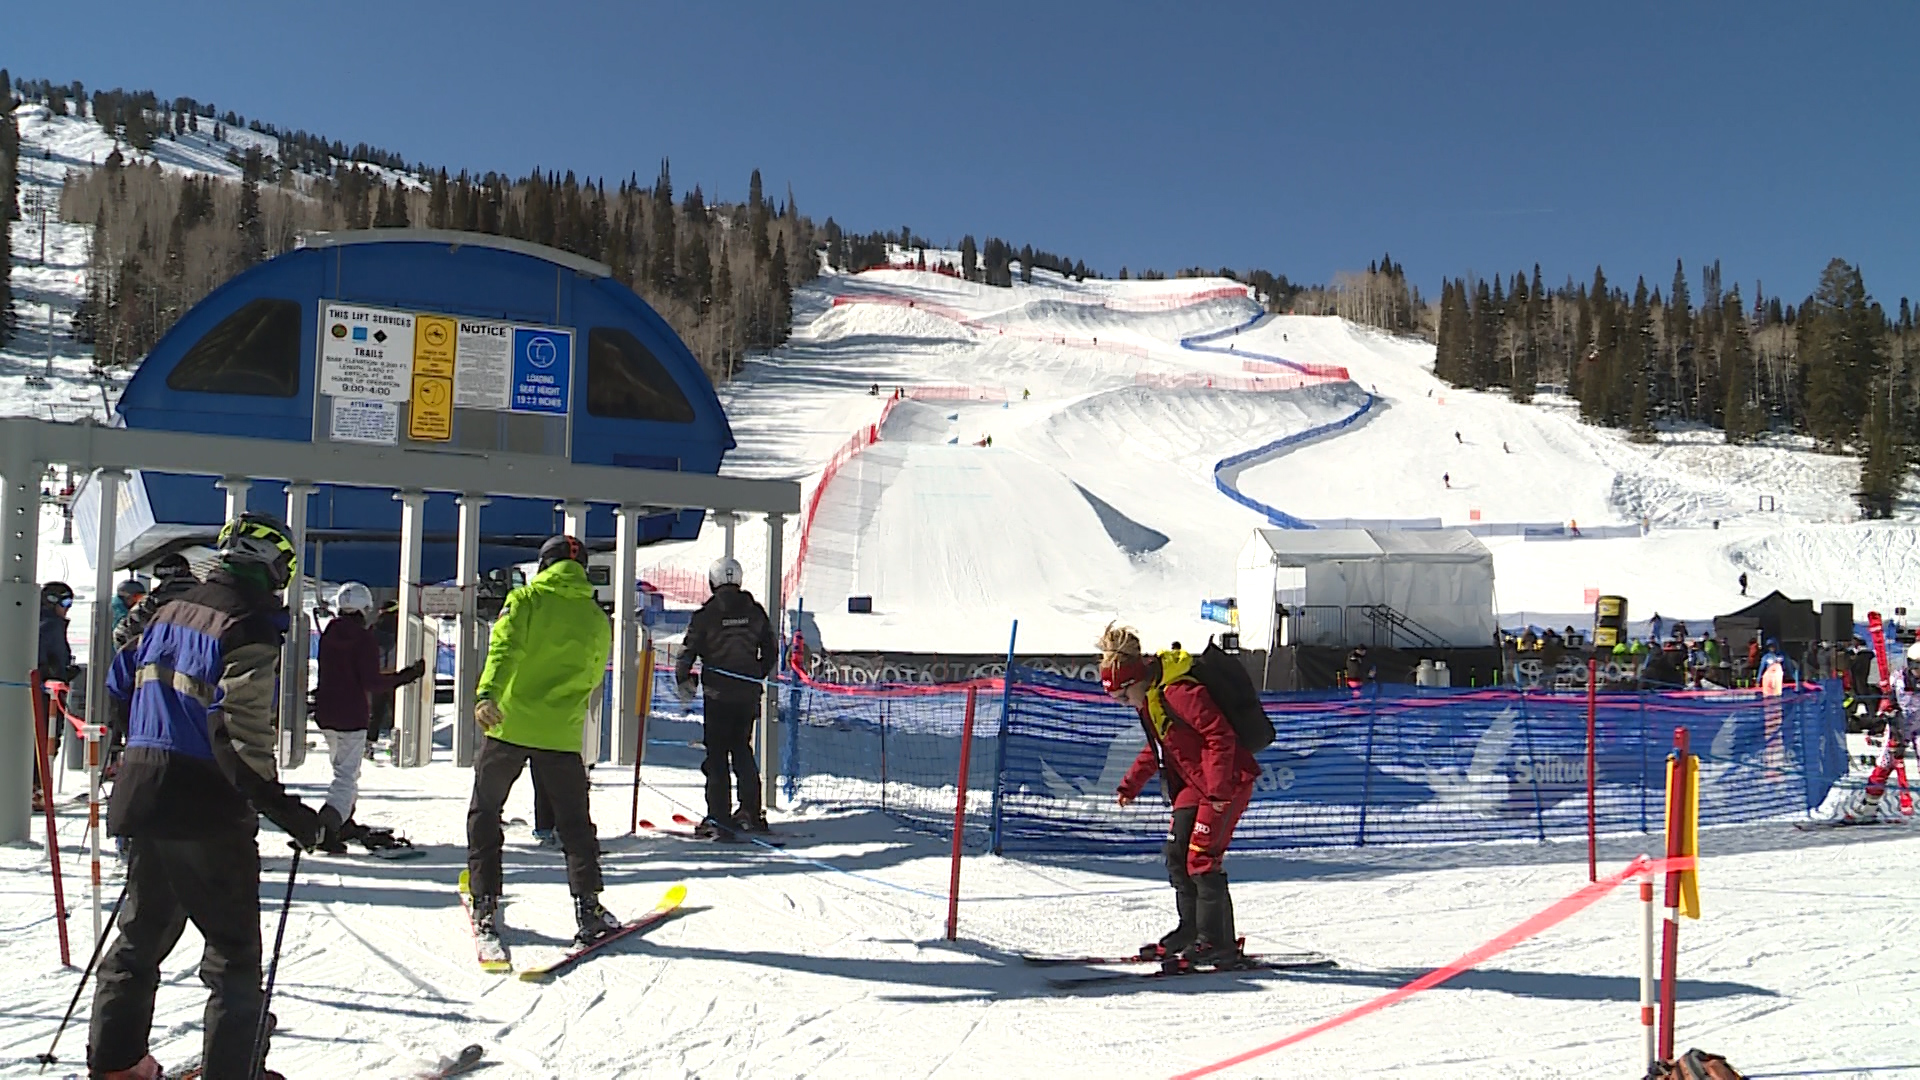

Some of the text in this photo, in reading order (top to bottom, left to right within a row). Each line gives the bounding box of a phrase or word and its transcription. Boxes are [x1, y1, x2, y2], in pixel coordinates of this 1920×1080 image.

[329, 309, 412, 328] THIS LIFT SERVICES
[460, 323, 507, 338] NOTICE
[354, 347, 384, 359] TRAILS
